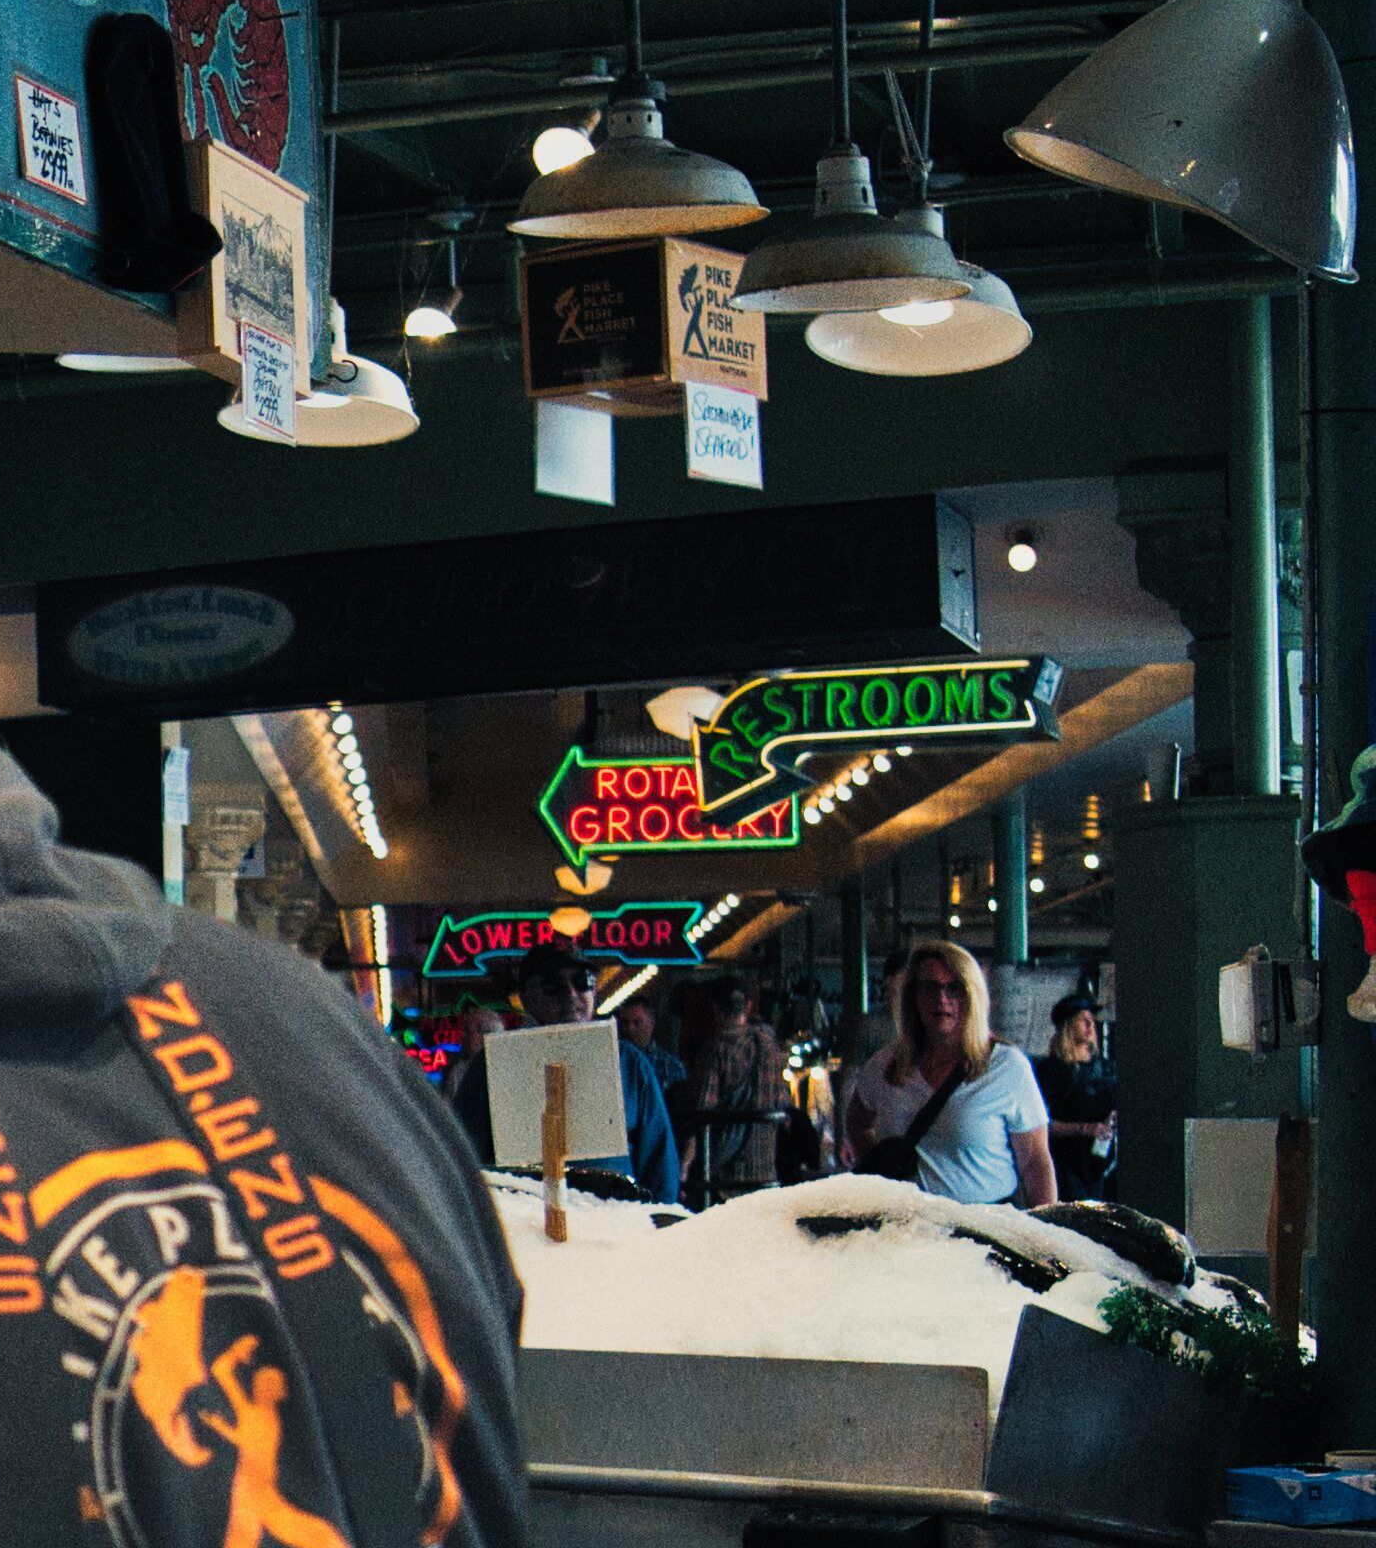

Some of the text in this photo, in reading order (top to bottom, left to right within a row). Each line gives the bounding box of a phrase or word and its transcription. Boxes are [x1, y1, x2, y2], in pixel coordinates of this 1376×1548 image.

[705, 264, 732, 289] PIKE
[707, 312, 733, 334] FISH
[707, 336, 756, 362] MARKET
[708, 669, 1017, 781] RESTROOMS
[596, 764, 697, 802] ROTA
